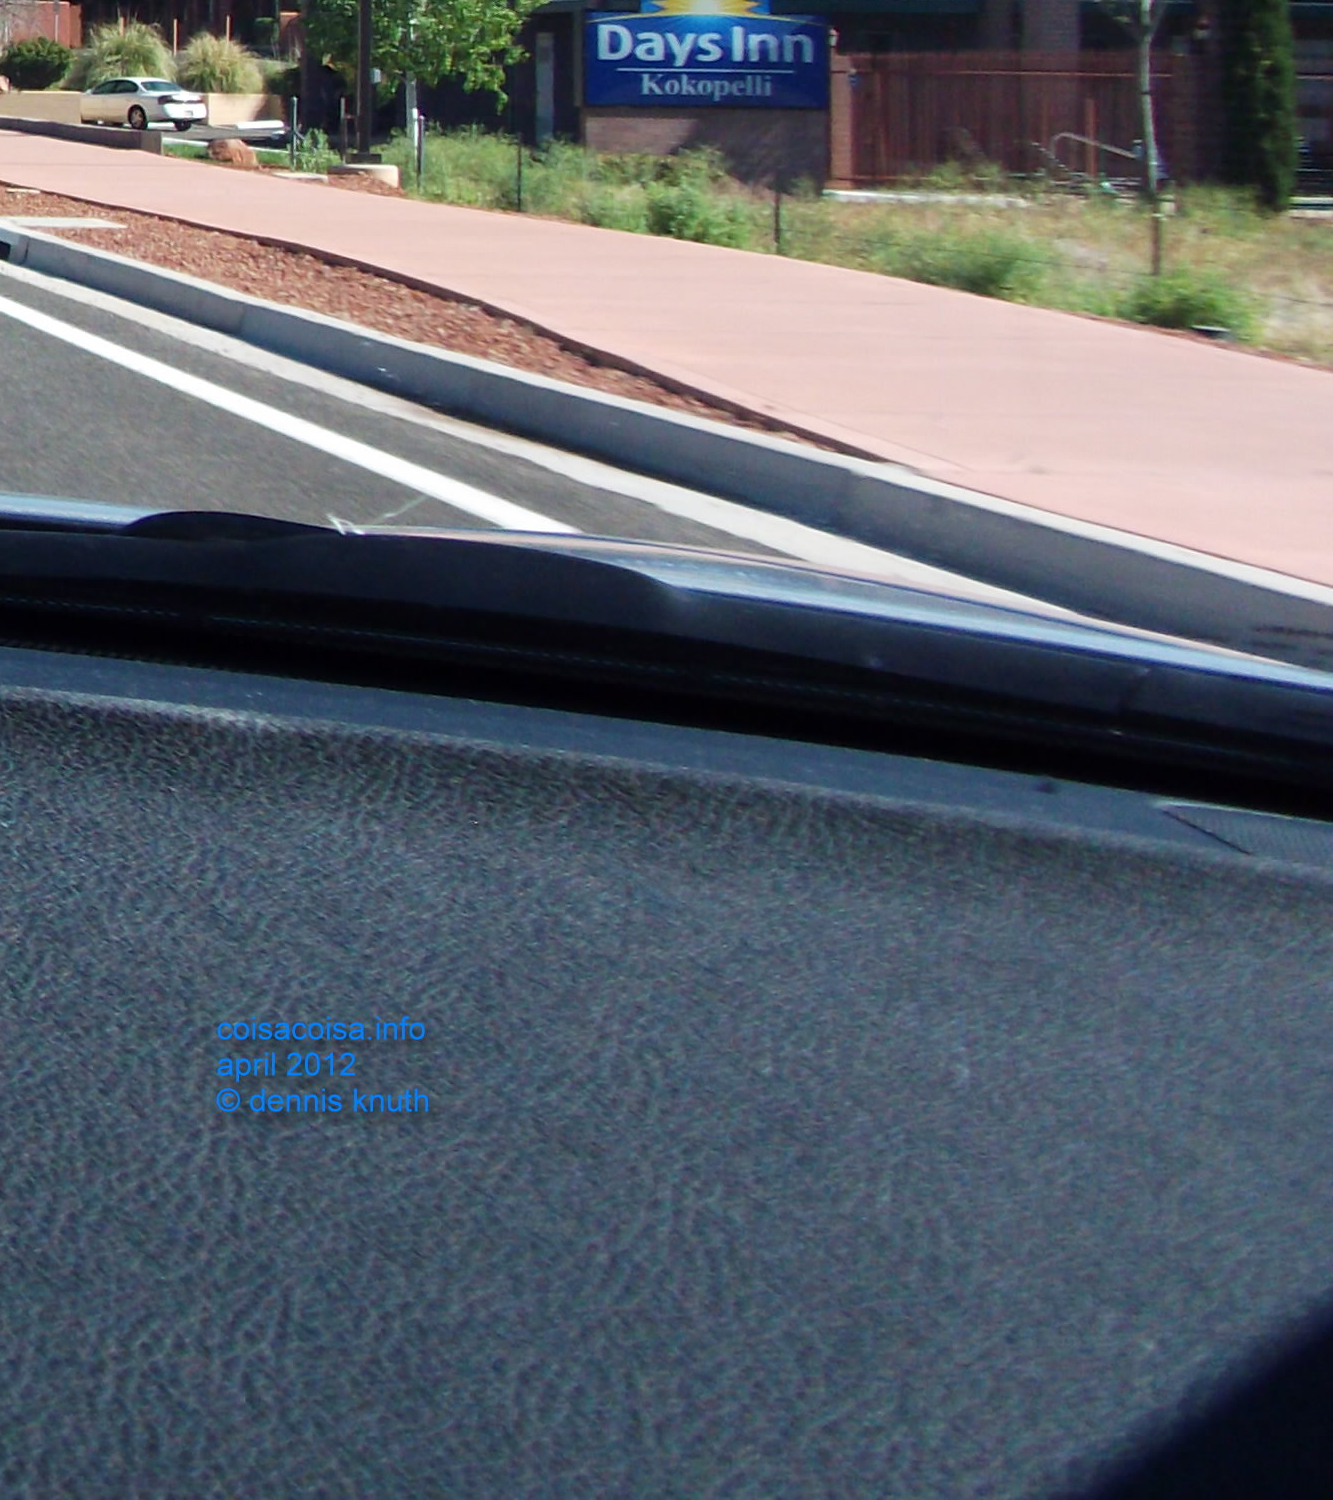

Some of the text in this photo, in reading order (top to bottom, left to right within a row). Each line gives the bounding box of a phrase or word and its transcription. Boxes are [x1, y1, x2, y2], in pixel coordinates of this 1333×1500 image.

[596, 24, 814, 66] Days Inn
[639, 73, 773, 101] Kokopelli
